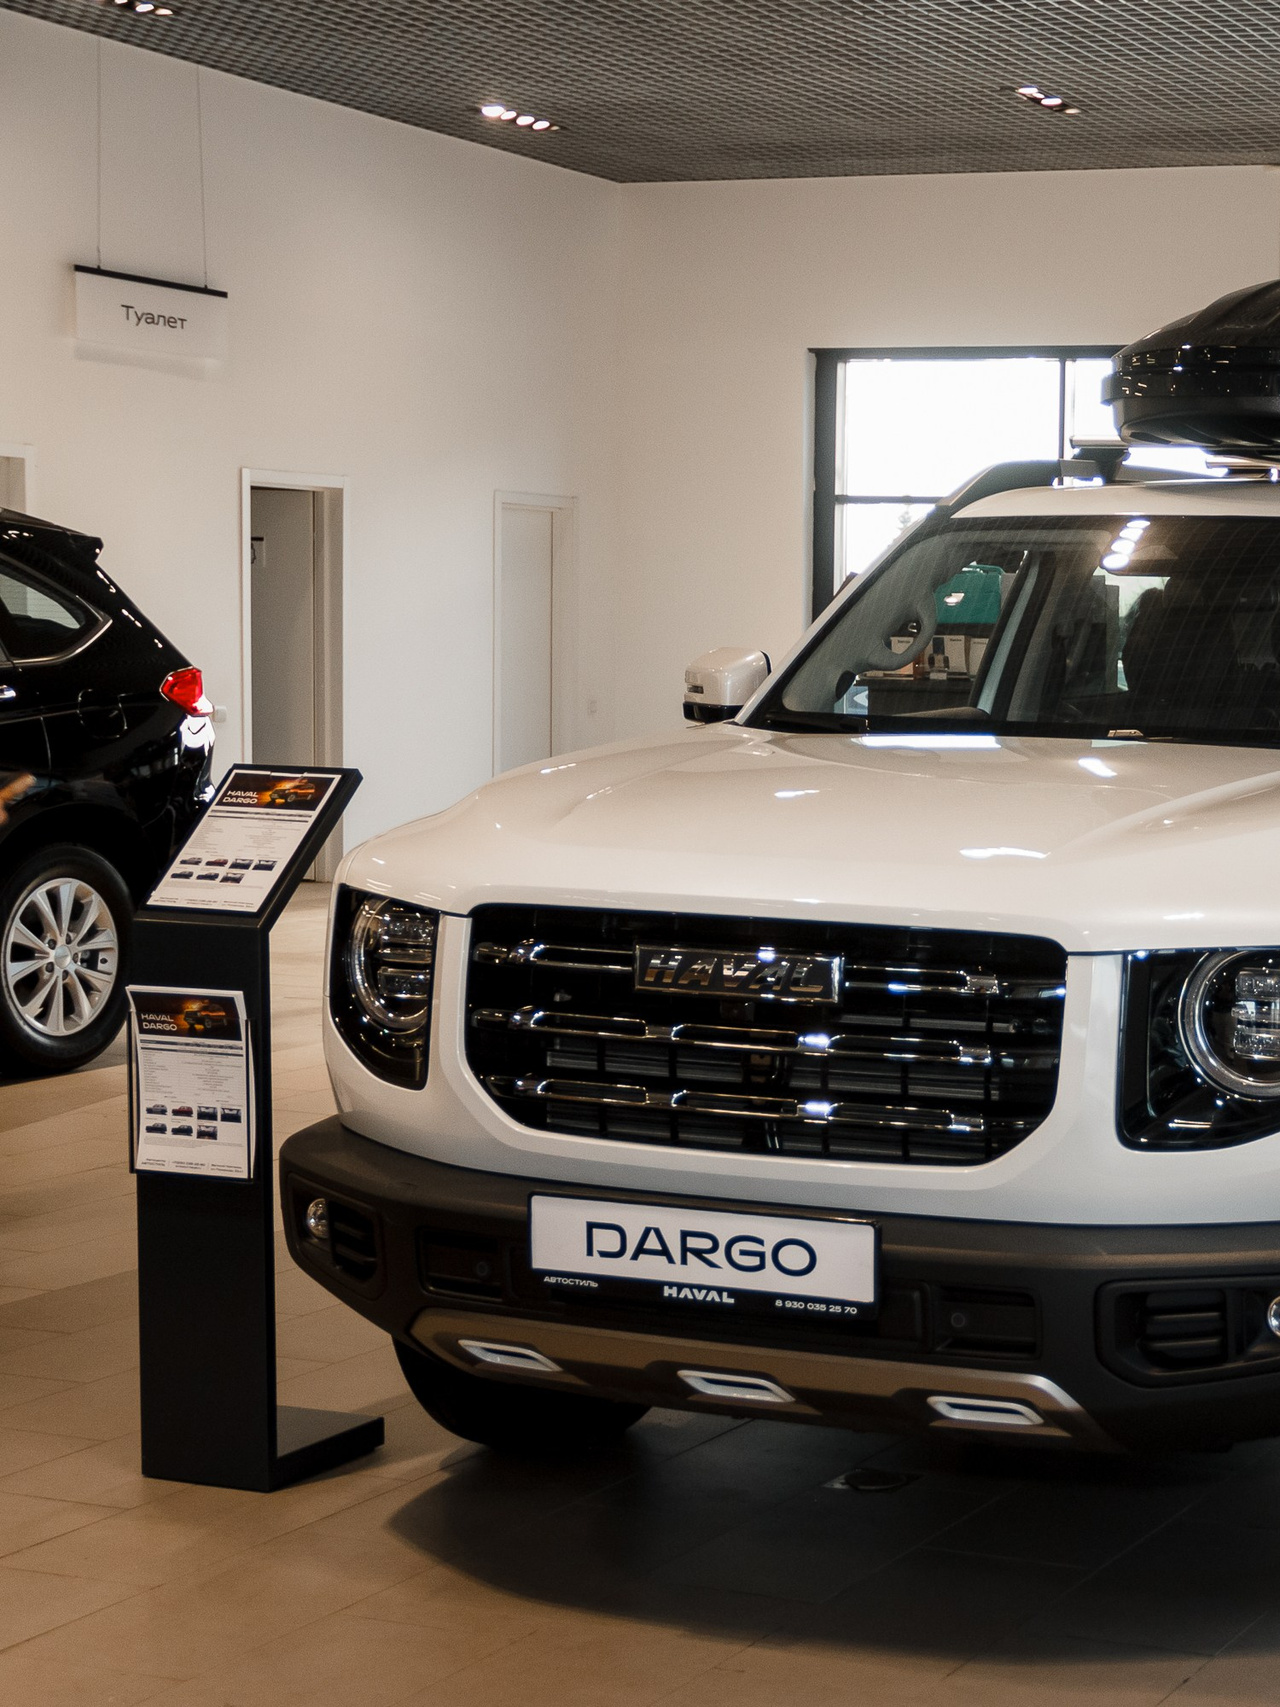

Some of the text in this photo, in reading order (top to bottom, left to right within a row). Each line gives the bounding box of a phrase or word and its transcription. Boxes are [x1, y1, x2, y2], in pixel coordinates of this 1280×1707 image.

[120, 303, 188, 330] Туалет
[222, 796, 258, 804] DARGO
[226, 790, 259, 798] HAVAL
[644, 953, 823, 992] HAVAL
[141, 1013, 174, 1022] HAVAL
[142, 1021, 178, 1031] DARGO
[585, 1220, 818, 1277] DARGO
[543, 1275, 599, 1288] АВТОСТИЛЬ
[663, 1285, 735, 1304] HAVAL
[775, 1299, 858, 1314] 8 930 035 25 70
